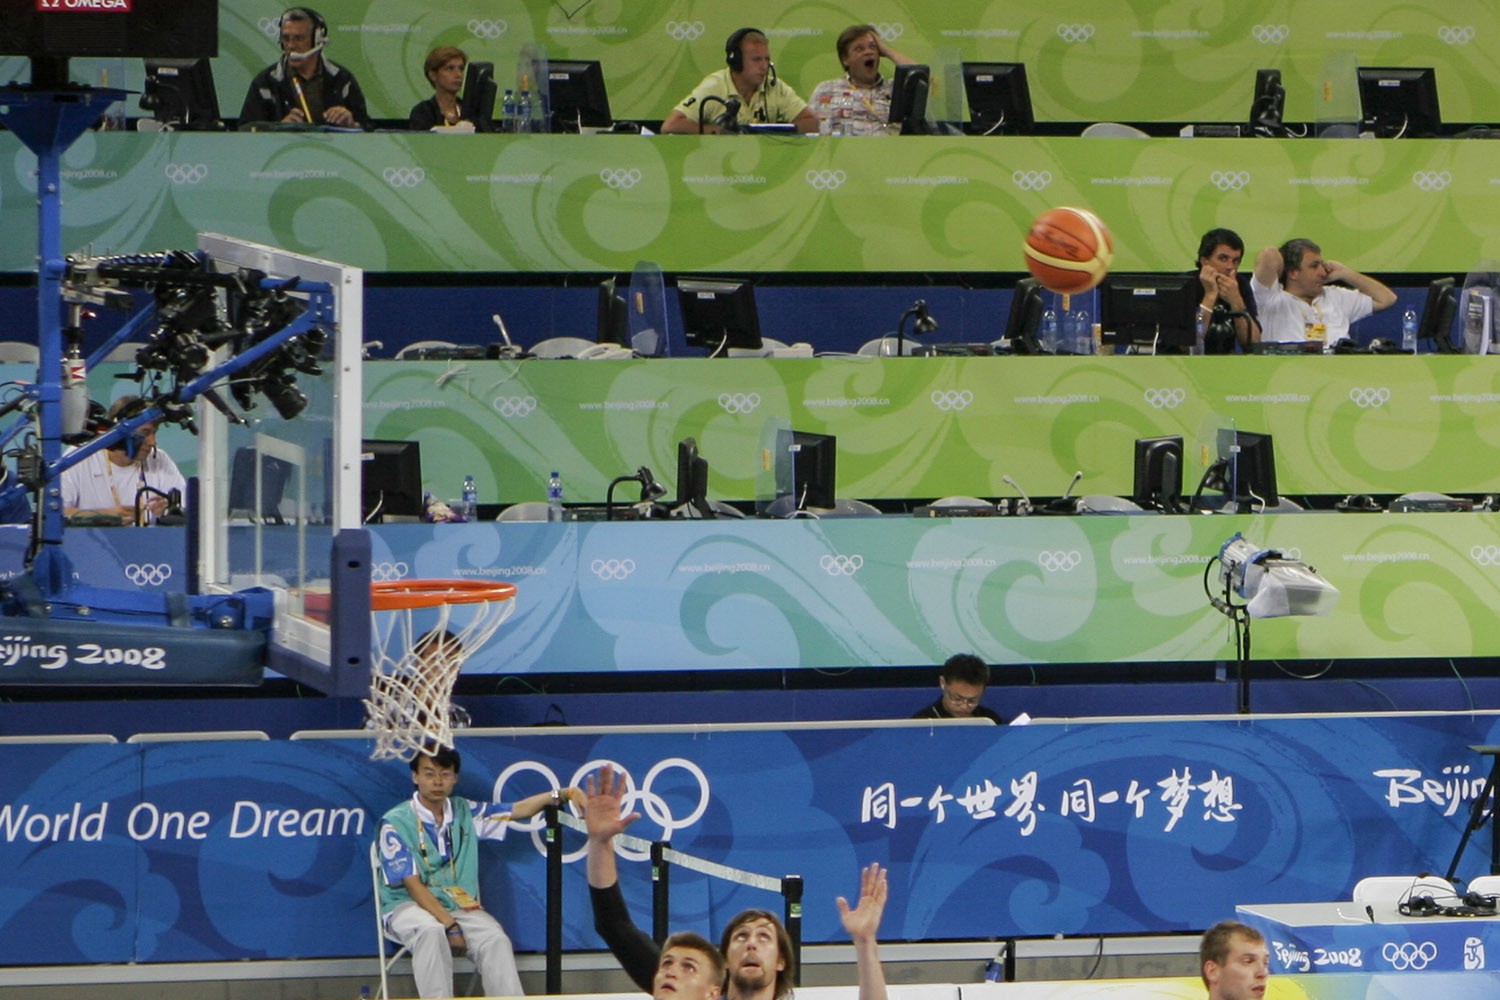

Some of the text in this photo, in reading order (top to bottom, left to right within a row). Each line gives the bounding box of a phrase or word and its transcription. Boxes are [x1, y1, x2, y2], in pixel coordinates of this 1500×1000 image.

[905, 556, 997, 571] www.beijing2008.cn
[1342, 548, 1430, 563] www.beijing2008.cn
[452, 563, 547, 578] www.beijing2008.cn
[677, 560, 771, 575] www.beijing2008.cn
[74, 643, 166, 670] 2008
[861, 766, 1243, 836] 同一个世界 同一个梦想
[127, 802, 210, 841] One
[229, 801, 365, 839] Dream
[1313, 947, 1362, 967] 2008
